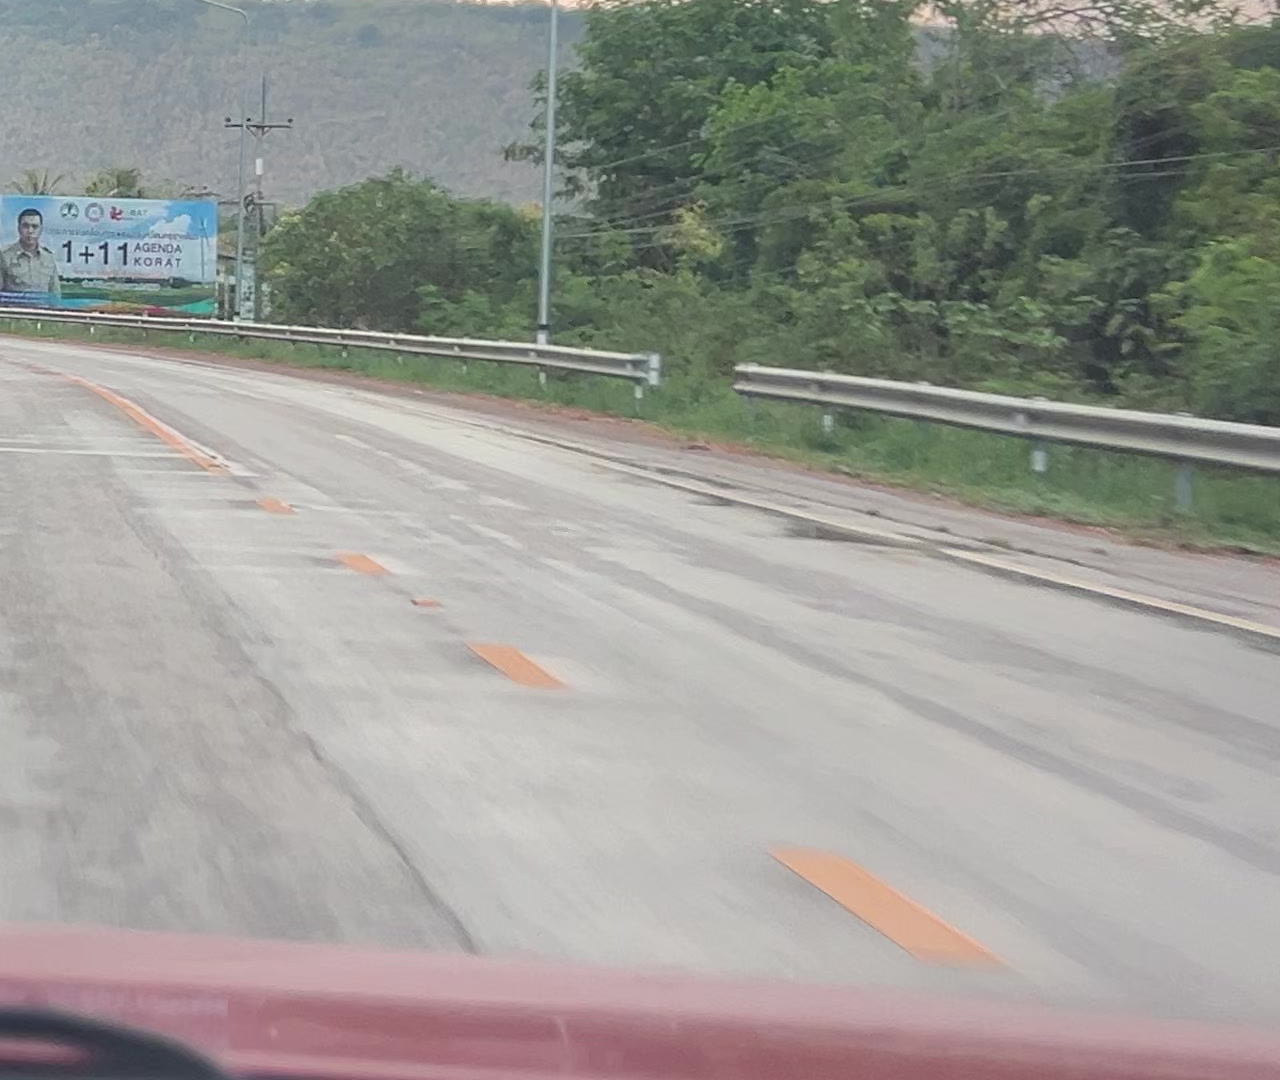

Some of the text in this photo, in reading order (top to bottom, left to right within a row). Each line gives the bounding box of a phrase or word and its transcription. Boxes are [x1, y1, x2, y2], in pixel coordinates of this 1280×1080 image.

[61, 240, 129, 266] 1+11
[133, 243, 182, 254] AGENDA
[133, 256, 182, 267] KORAT
